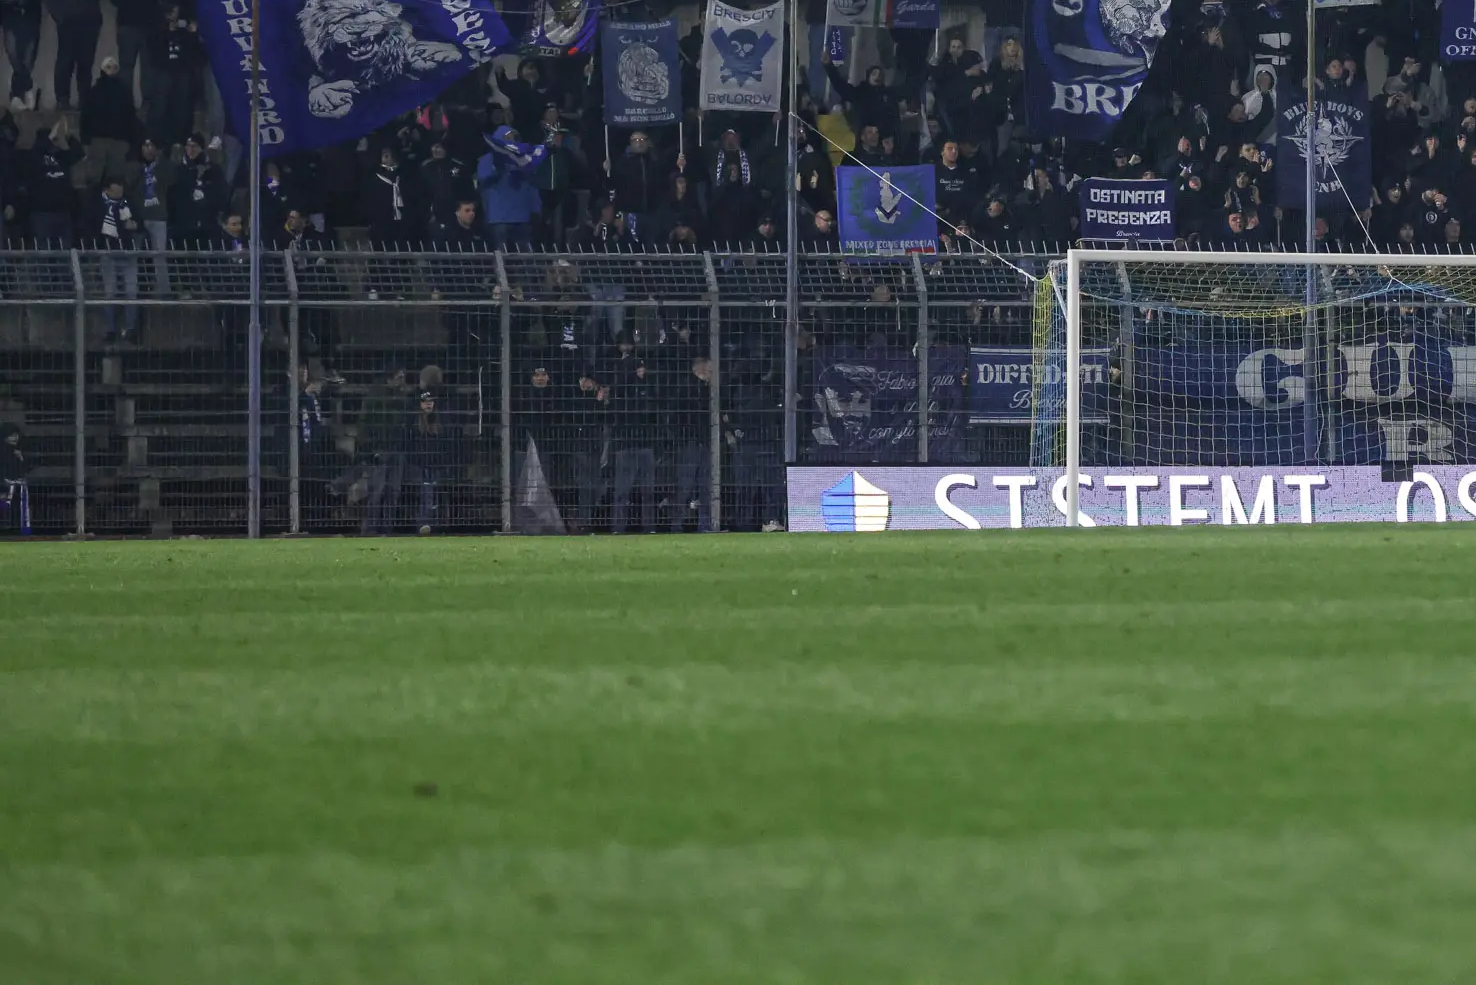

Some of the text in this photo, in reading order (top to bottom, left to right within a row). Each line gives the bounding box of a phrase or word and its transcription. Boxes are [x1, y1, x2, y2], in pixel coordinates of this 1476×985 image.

[713, 4, 776, 24] BRESCIA
[707, 93, 772, 105] BALORDA
[1327, 100, 1364, 121] BOYS
[1090, 188, 1166, 204] OSTINATA
[1086, 208, 1172, 225] PRESENZA
[976, 363, 1105, 385] DIFFIDTI
